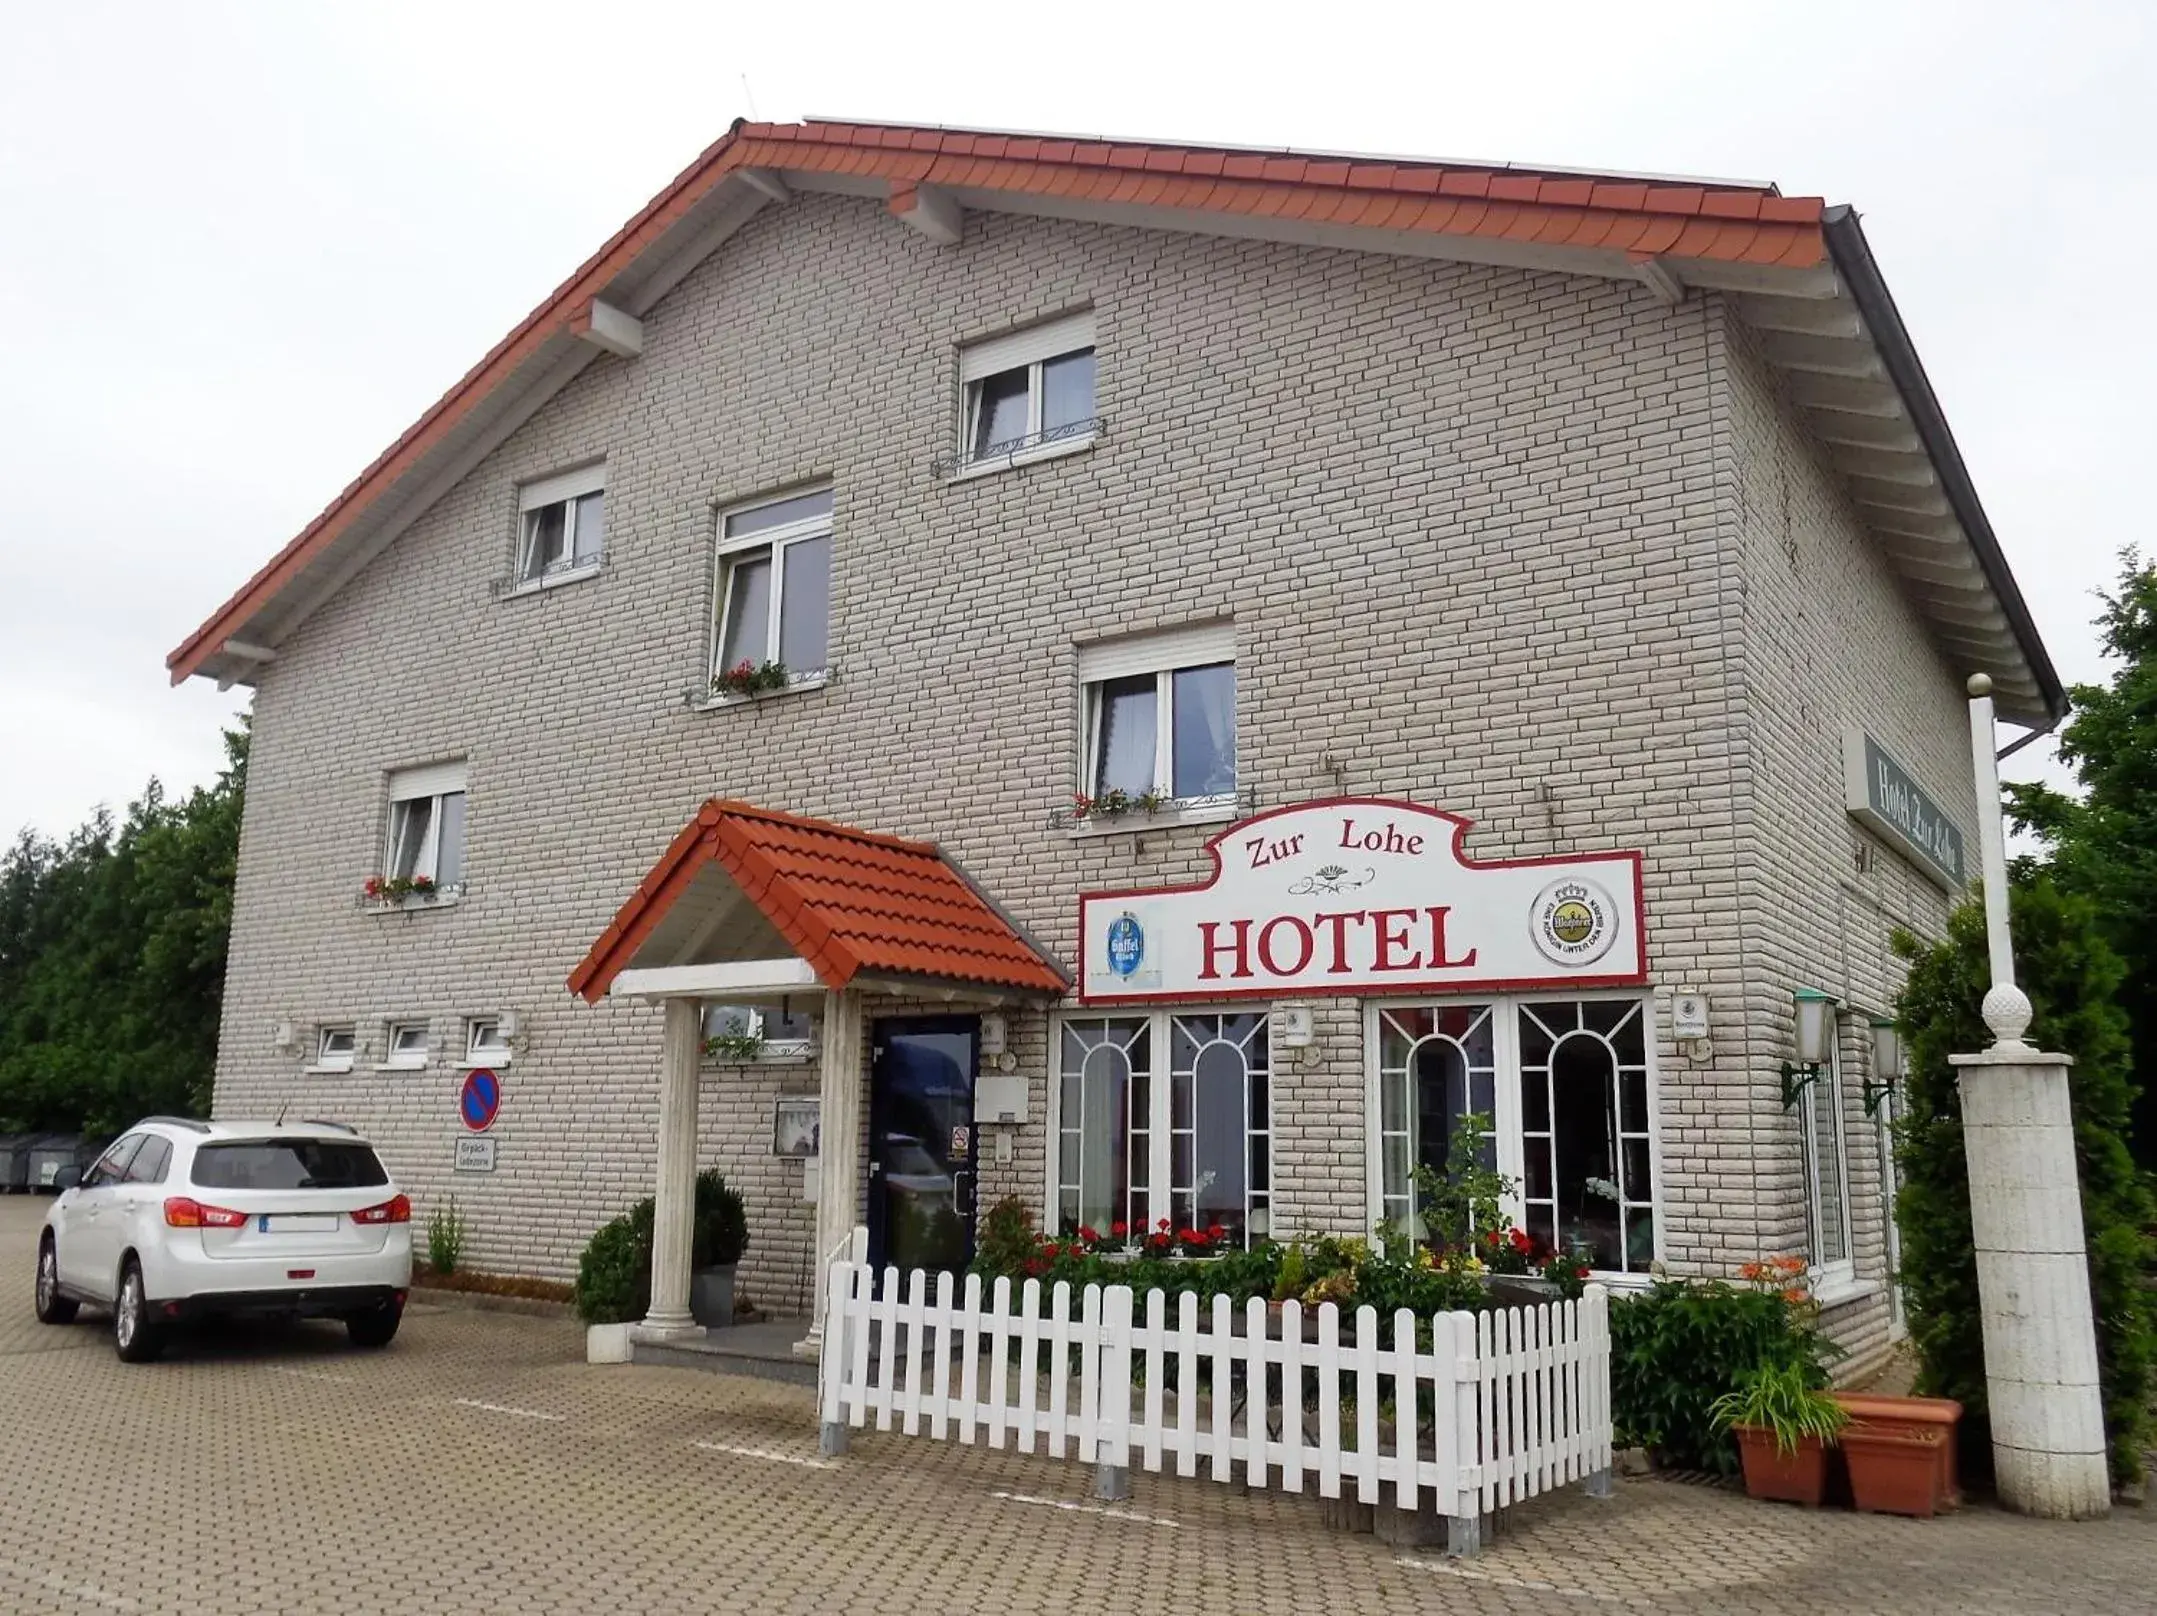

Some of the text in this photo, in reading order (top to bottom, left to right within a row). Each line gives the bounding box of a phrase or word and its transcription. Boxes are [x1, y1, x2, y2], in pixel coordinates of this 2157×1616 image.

[1876, 756, 1911, 831] Hotel
[1911, 792, 1933, 851] Zur
[1245, 818, 1425, 869] Zur Lohe
[1197, 905, 1478, 980] HOTEL
